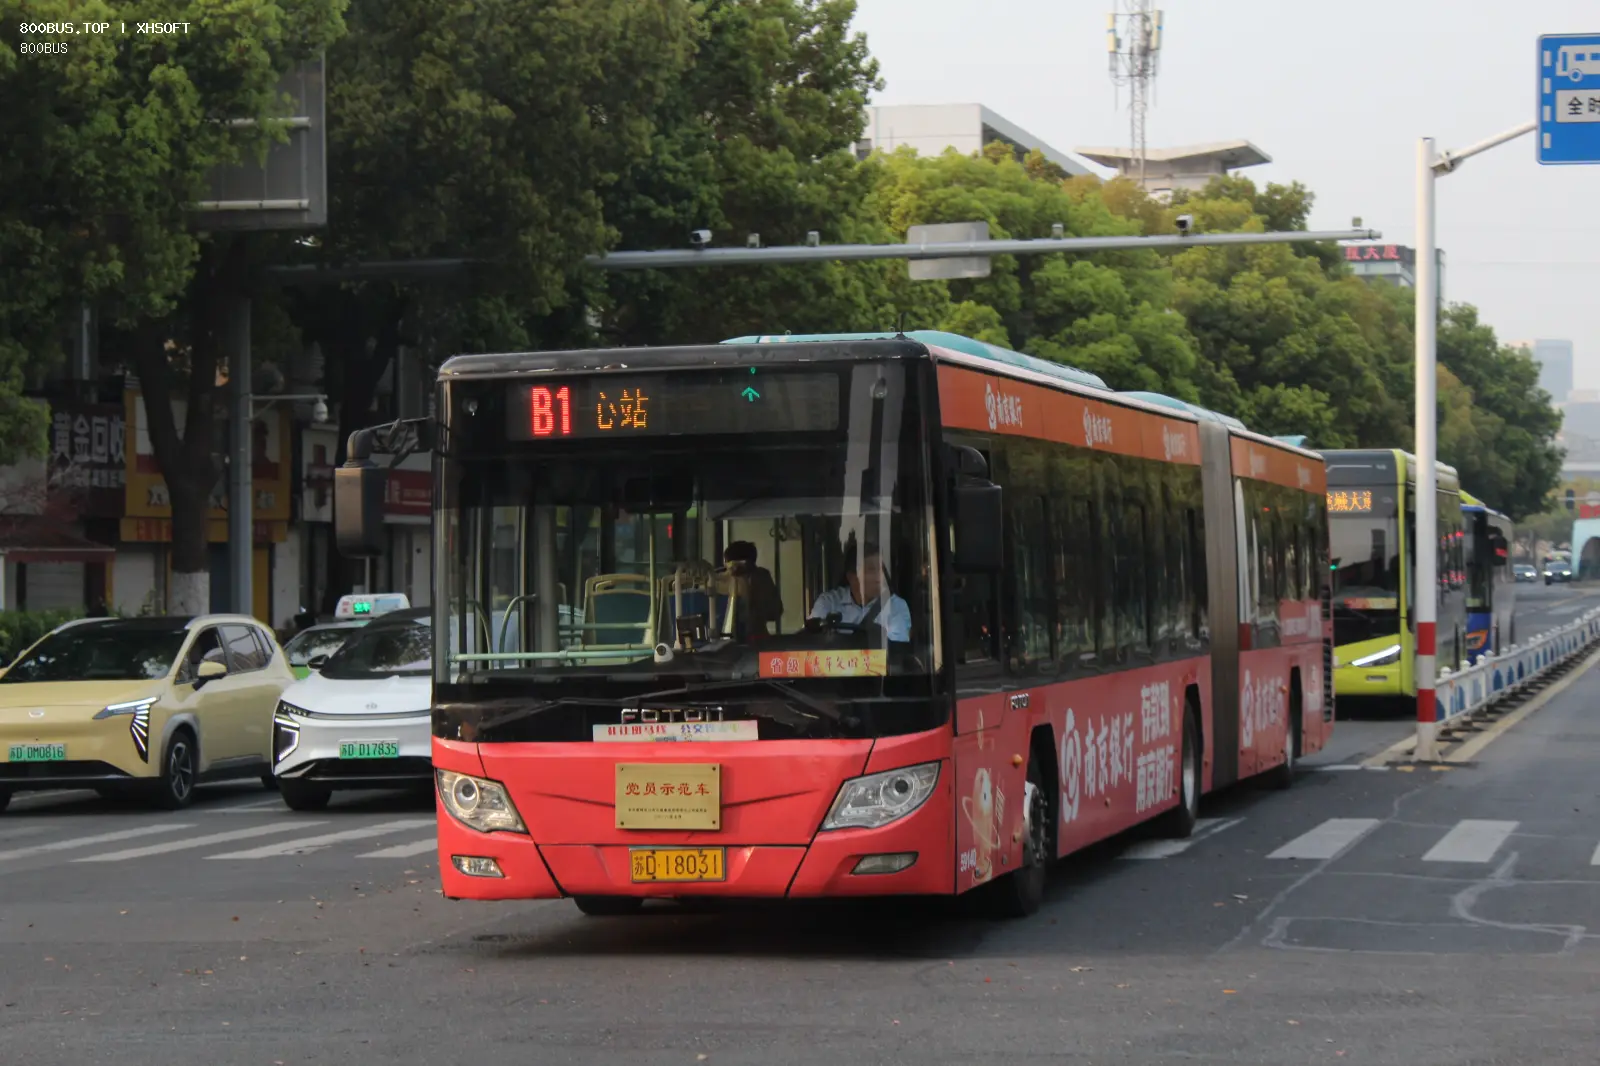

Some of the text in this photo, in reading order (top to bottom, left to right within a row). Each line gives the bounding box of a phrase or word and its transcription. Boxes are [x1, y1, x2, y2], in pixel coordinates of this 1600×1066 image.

[532, 386, 649, 435] B1 心站
[625, 782, 710, 796] 党员示范车
